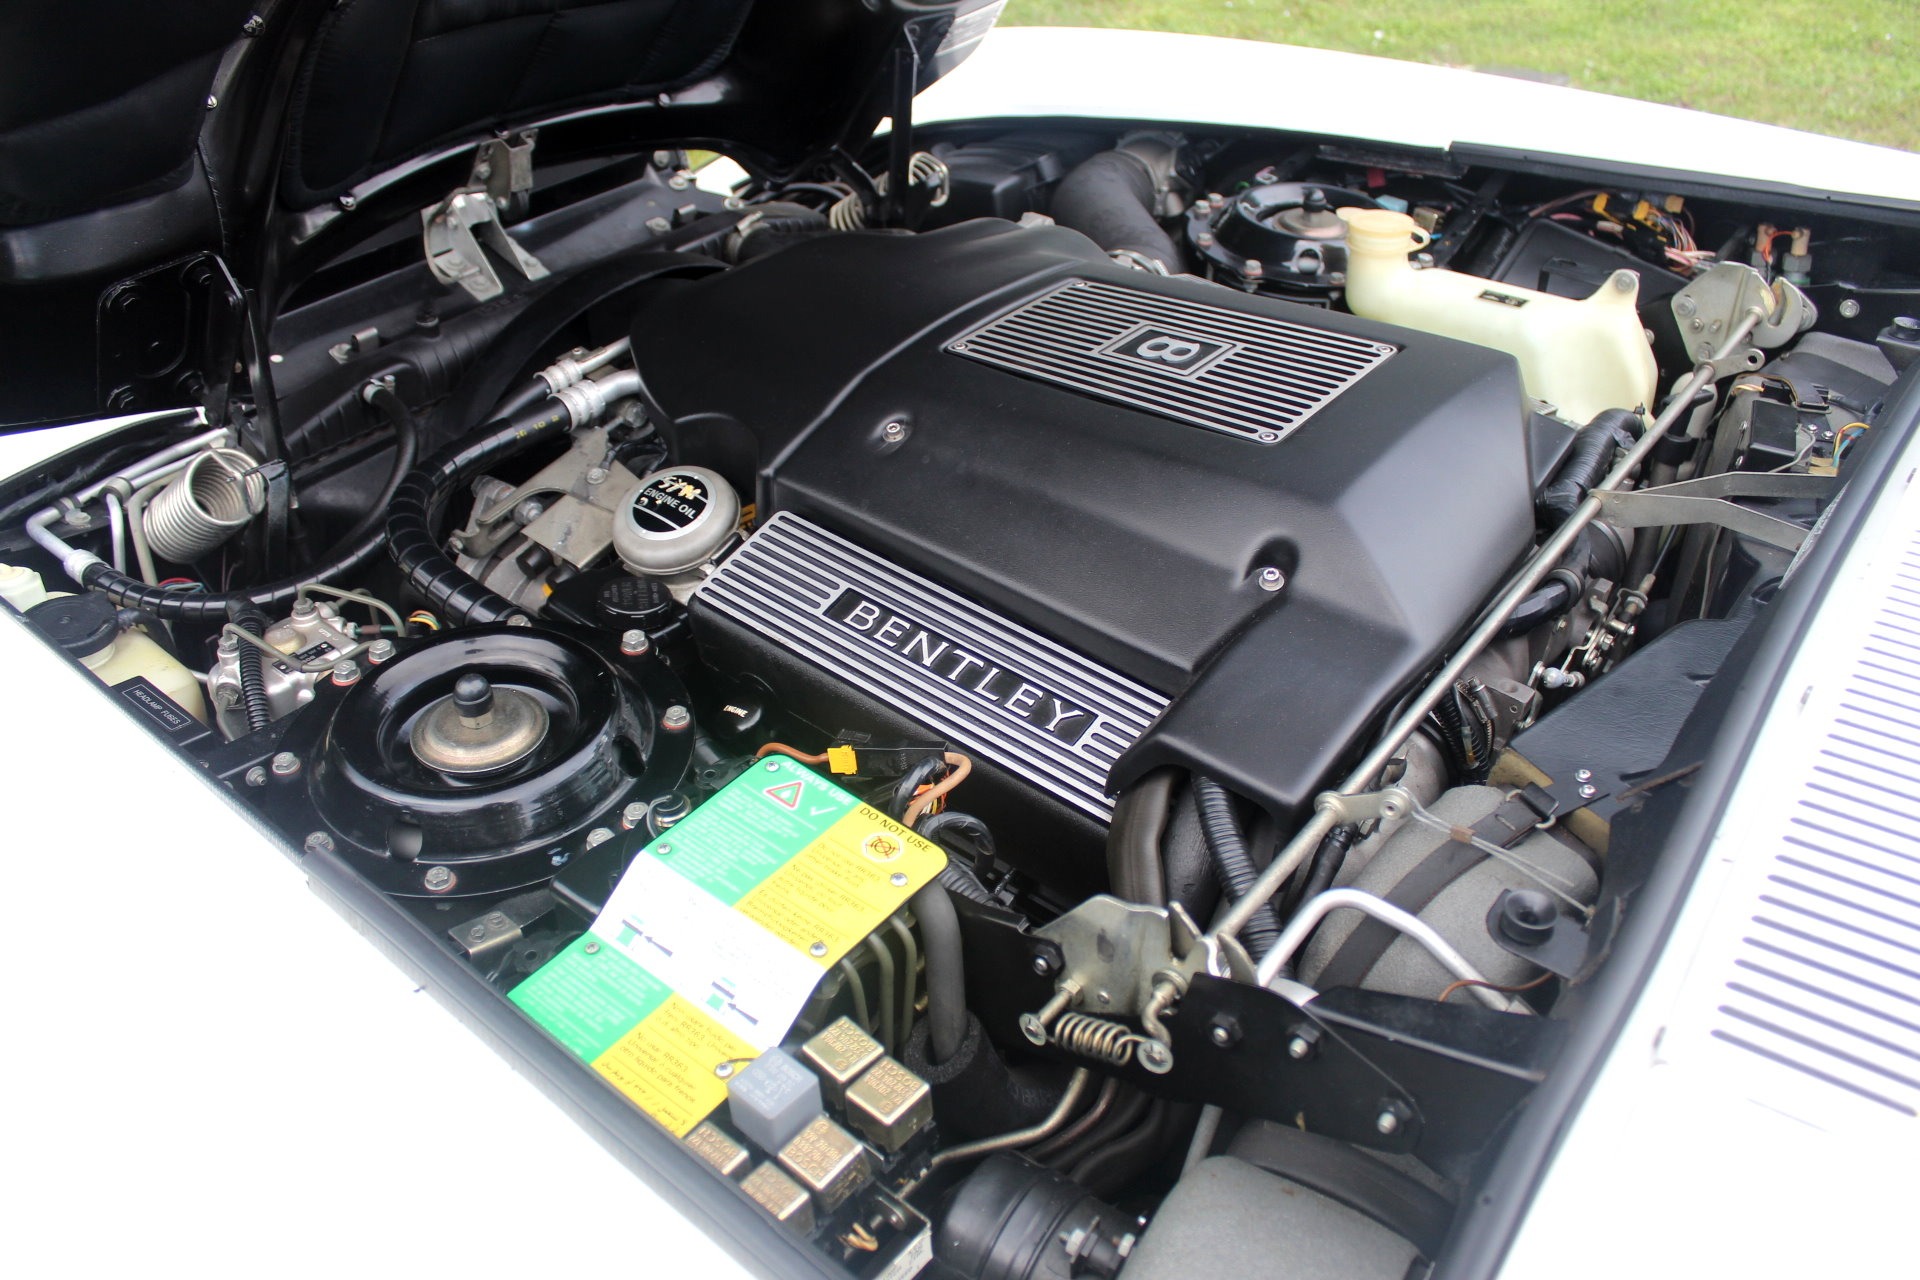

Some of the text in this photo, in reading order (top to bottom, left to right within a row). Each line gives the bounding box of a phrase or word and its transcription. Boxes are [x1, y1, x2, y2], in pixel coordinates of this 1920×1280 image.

[1136, 335, 1200, 362] 8
[643, 487, 697, 519] ENGINE OIL
[842, 600, 1084, 732] BENTLEY
[133, 689, 181, 724] HEADLAMP FUSES
[723, 704, 748, 718] ENGINE
[782, 760, 827, 790] ALWAYS
[827, 788, 852, 805] USE
[859, 807, 932, 853] DO NOT USE
